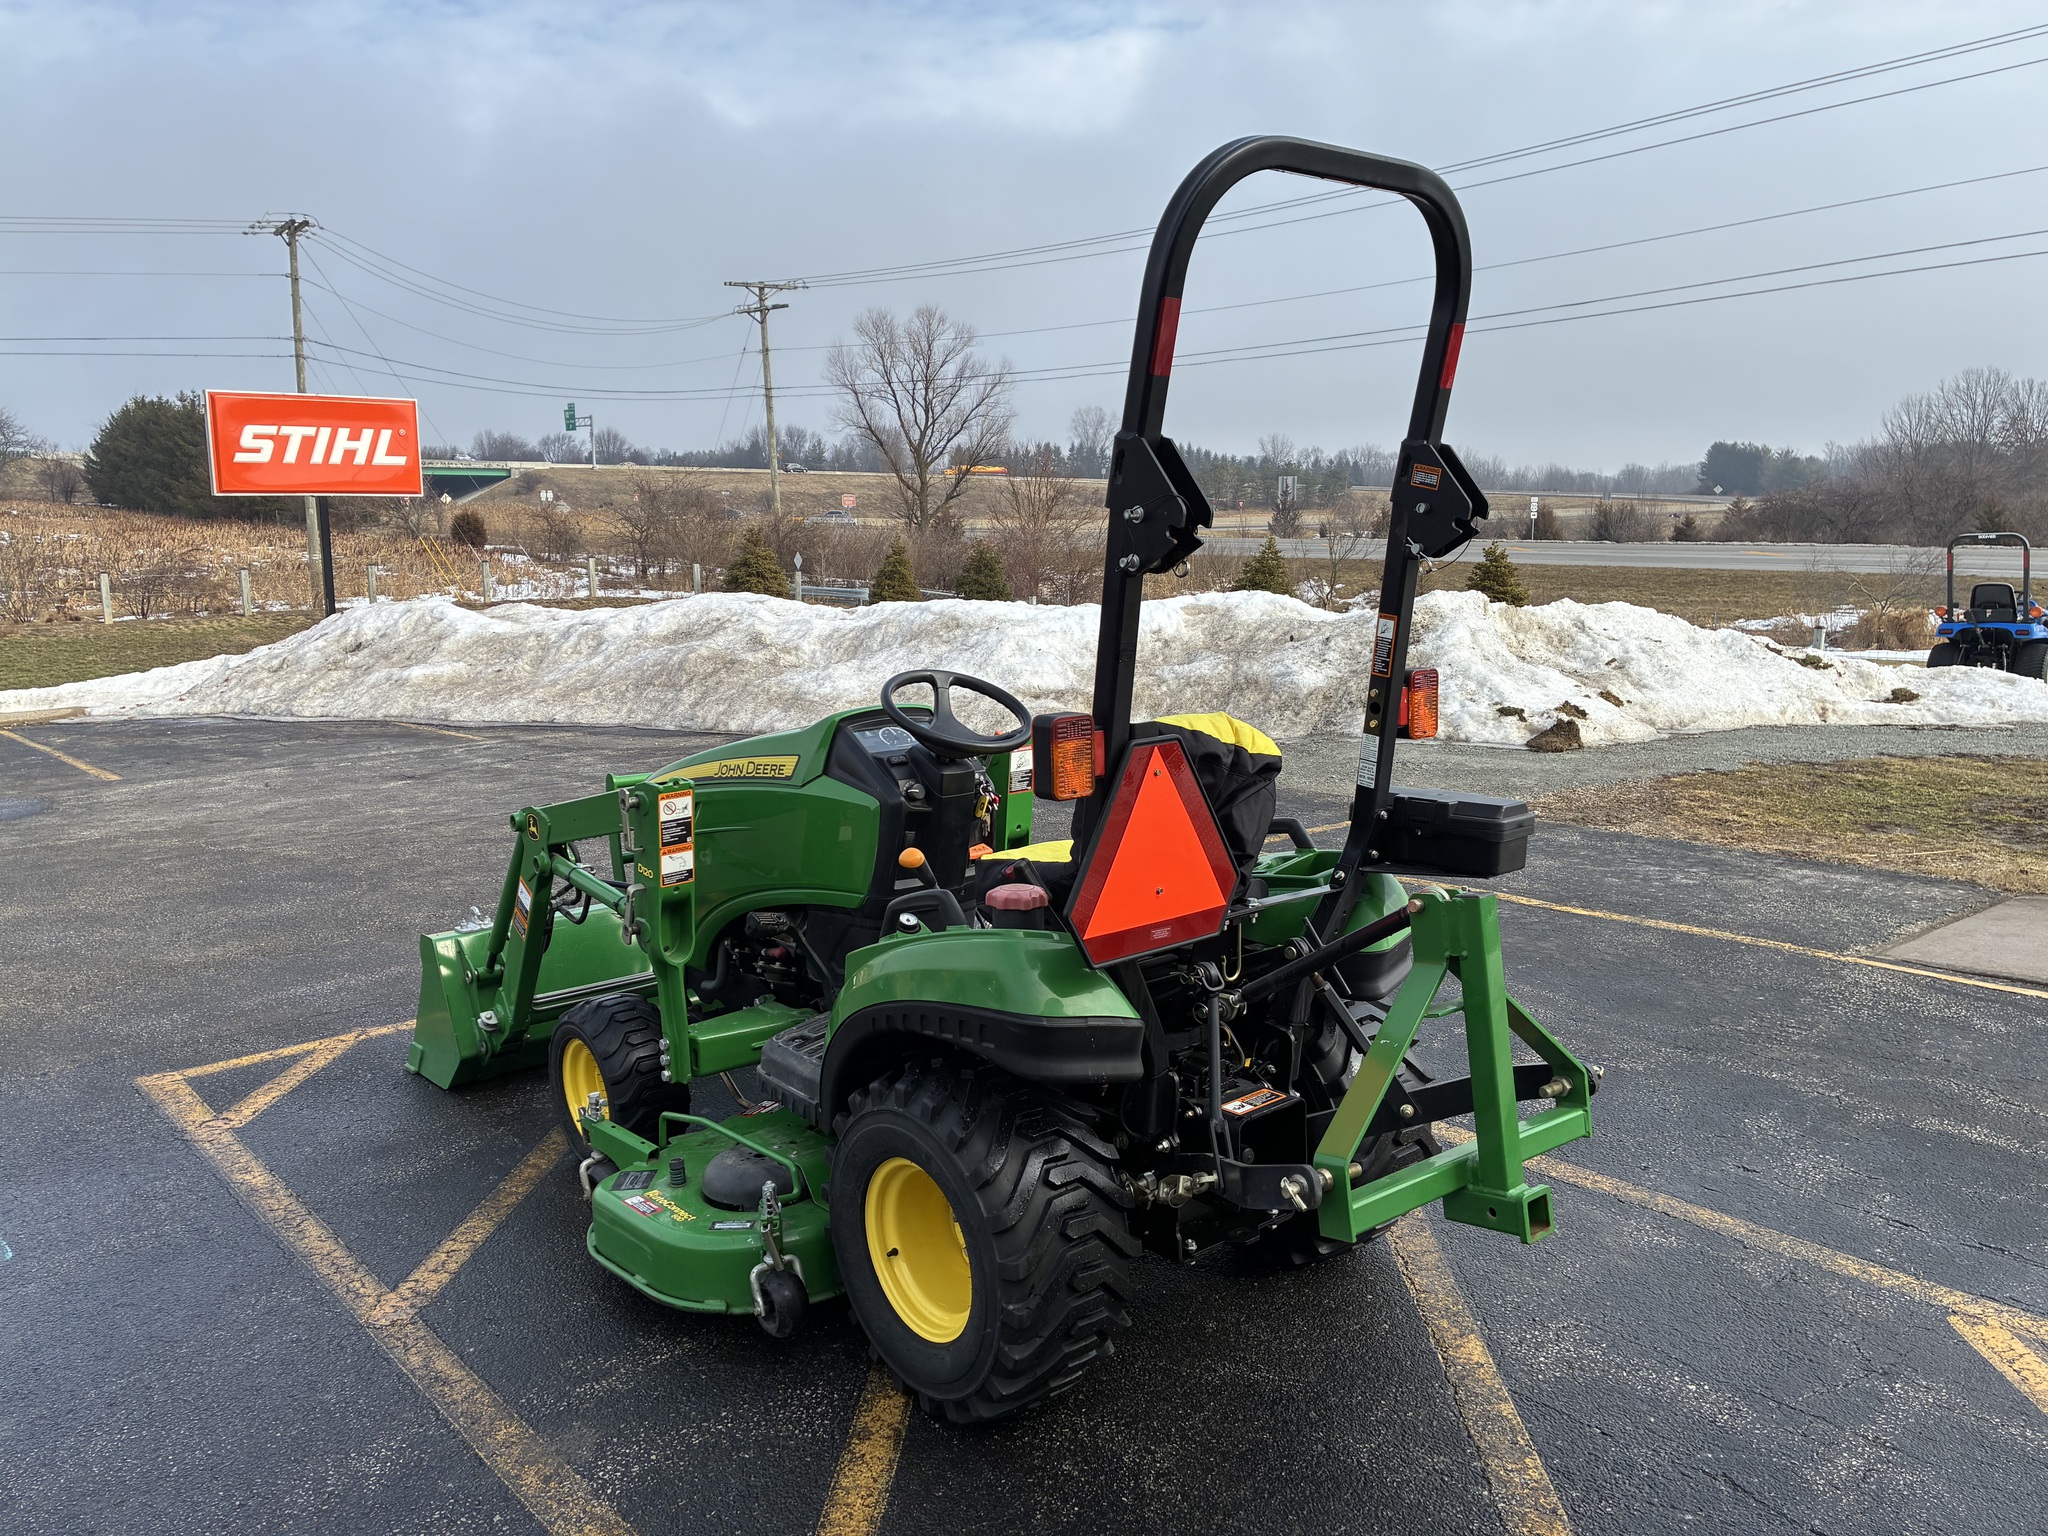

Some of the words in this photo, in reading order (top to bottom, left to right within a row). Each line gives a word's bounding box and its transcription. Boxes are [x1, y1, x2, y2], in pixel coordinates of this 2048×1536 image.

[233, 425, 407, 465] STIHL
[714, 762, 744, 776] JOHN
[746, 761, 786, 775] DEERE
[665, 790, 691, 799] WARNING
[667, 844, 692, 854] WARNING
[643, 1190, 697, 1221] AutoConnect
